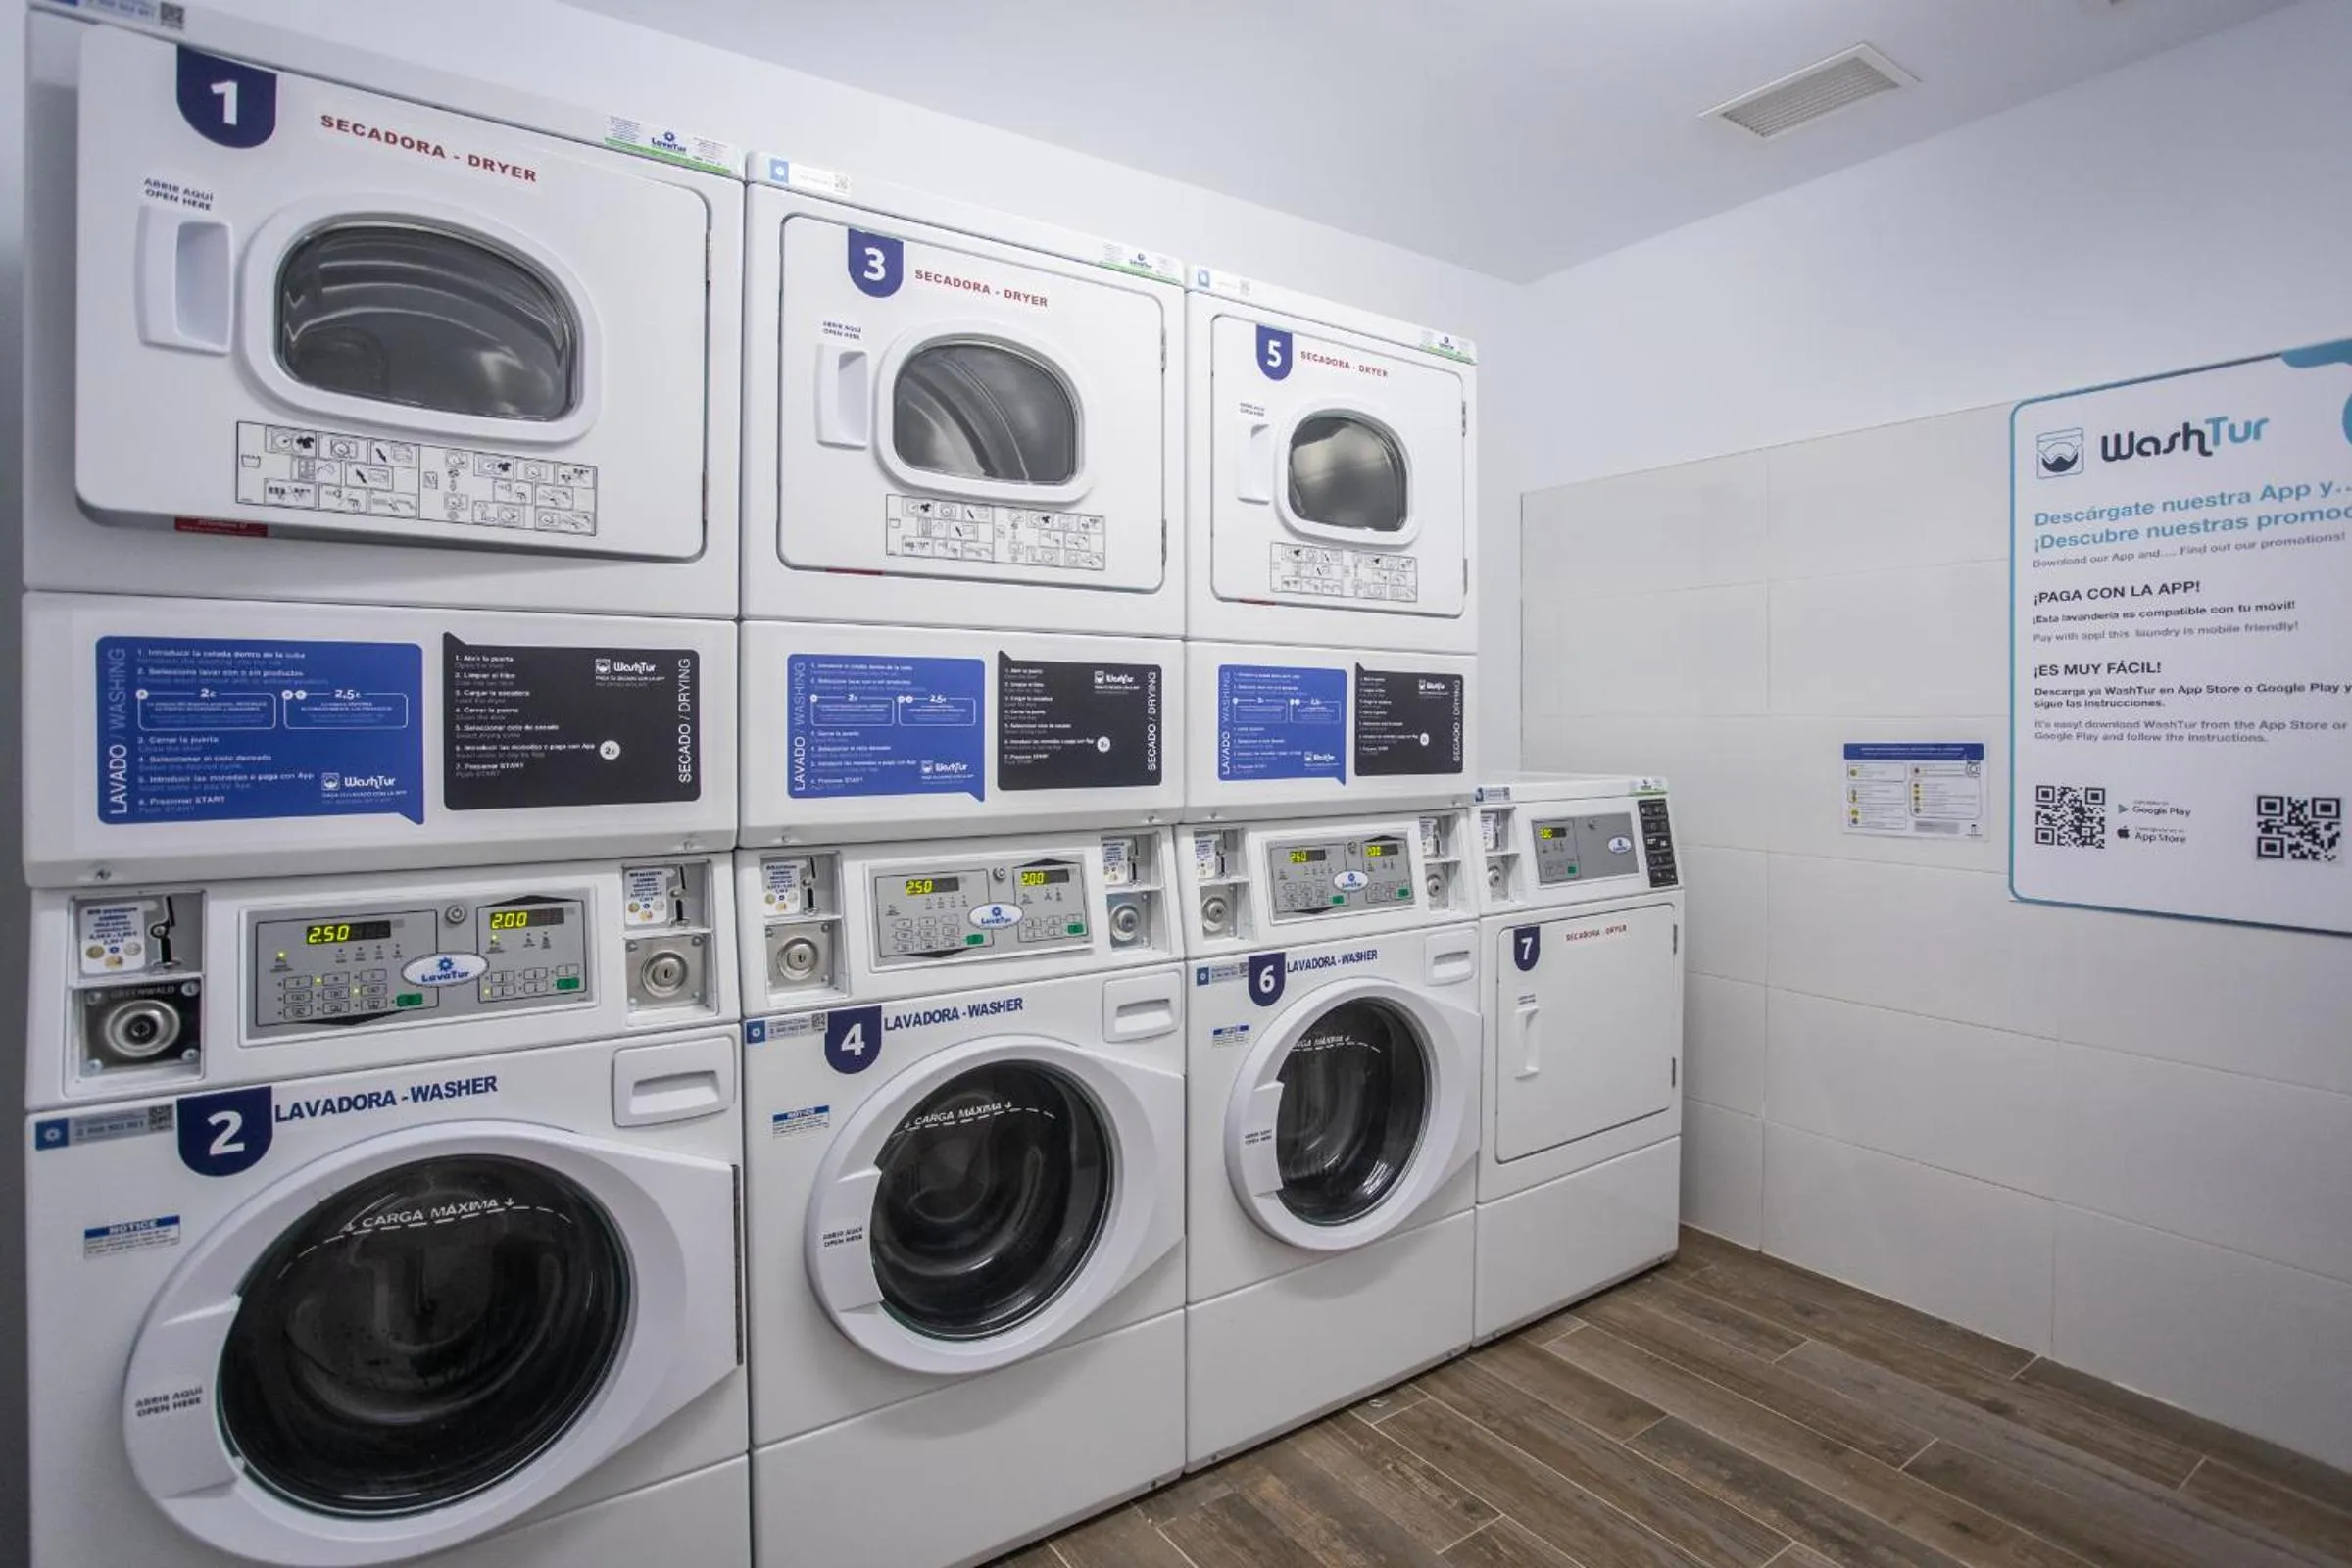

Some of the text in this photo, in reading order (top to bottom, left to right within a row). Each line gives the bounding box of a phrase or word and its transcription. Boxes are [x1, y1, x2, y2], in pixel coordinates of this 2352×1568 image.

[210, 80, 238, 126] 1
[320, 115, 538, 182] SECADORA DRYER
[863, 247, 887, 281] 3
[914, 269, 1049, 307] SECADORA DRYER
[1267, 340, 1282, 367] 5
[1300, 351, 1389, 378] SECADORA DRYER
[2101, 416, 2270, 463] WashTur
[2034, 483, 2312, 526] Descárgate nuestra App
[2146, 516, 2249, 539] nuestras
[2033, 532, 2345, 568] Download our App Find out our promotions!
[2087, 586, 2126, 600] CON
[2131, 584, 2153, 597] LA
[2158, 580, 2201, 595] APP!
[2138, 605, 2207, 618] compatible
[2210, 605, 2234, 614] con
[2238, 604, 2252, 612] tu
[2034, 634, 2053, 644] Pay
[2055, 632, 2079, 641] with
[2108, 630, 2130, 639] this
[2135, 627, 2181, 638] laundry
[2197, 625, 2240, 635] mobile
[2244, 621, 2299, 633] friendly!
[613, 662, 657, 674] WashTur
[2064, 663, 2102, 675] MUY
[2107, 660, 2162, 674] FÁCIL!
[2034, 687, 2086, 697] Descarga
[2088, 688, 2102, 697] ya
[2104, 686, 2157, 695] WashTur
[2178, 685, 2203, 696] App
[2206, 684, 2241, 694] Store
[2257, 683, 2305, 695] Google
[2309, 682, 2340, 694] Play
[2034, 699, 2063, 709] sigue
[2066, 699, 2082, 708] las
[108, 648, 128, 814] LAVADO WASHING
[678, 658, 692, 783] SECADO DRYING
[794, 662, 806, 792] LAVADO WASHING
[1148, 671, 1156, 771] SECADO DRYING
[2084, 720, 2141, 729] download
[2144, 720, 2198, 729] WashTur
[2201, 720, 2230, 730] from
[2234, 720, 2256, 730] the
[2259, 720, 2286, 732] App
[2289, 719, 2328, 730] Store
[2332, 721, 2348, 730] or
[2034, 731, 2075, 743] Google
[2076, 732, 2100, 743] Play
[2102, 732, 2125, 741] and
[2127, 732, 2162, 742] follow
[2165, 732, 2185, 742] the
[345, 775, 396, 790] WashTur
[2132, 805, 2191, 817] Google Play
[2134, 832, 2186, 843] App Store
[1287, 949, 1378, 973] LAVADORA WASHER
[1521, 937, 1533, 960] 7
[421, 969, 470, 983] LavaTur
[1259, 965, 1275, 993] 6
[884, 997, 1023, 1031] LAVADORA WASHER
[841, 1023, 865, 1056] 4
[275, 1075, 498, 1123] LAVADORA WASHER
[915, 1111, 955, 1125] CARGA
[207, 1110, 245, 1156] 2
[362, 1210, 424, 1228] CARGA
